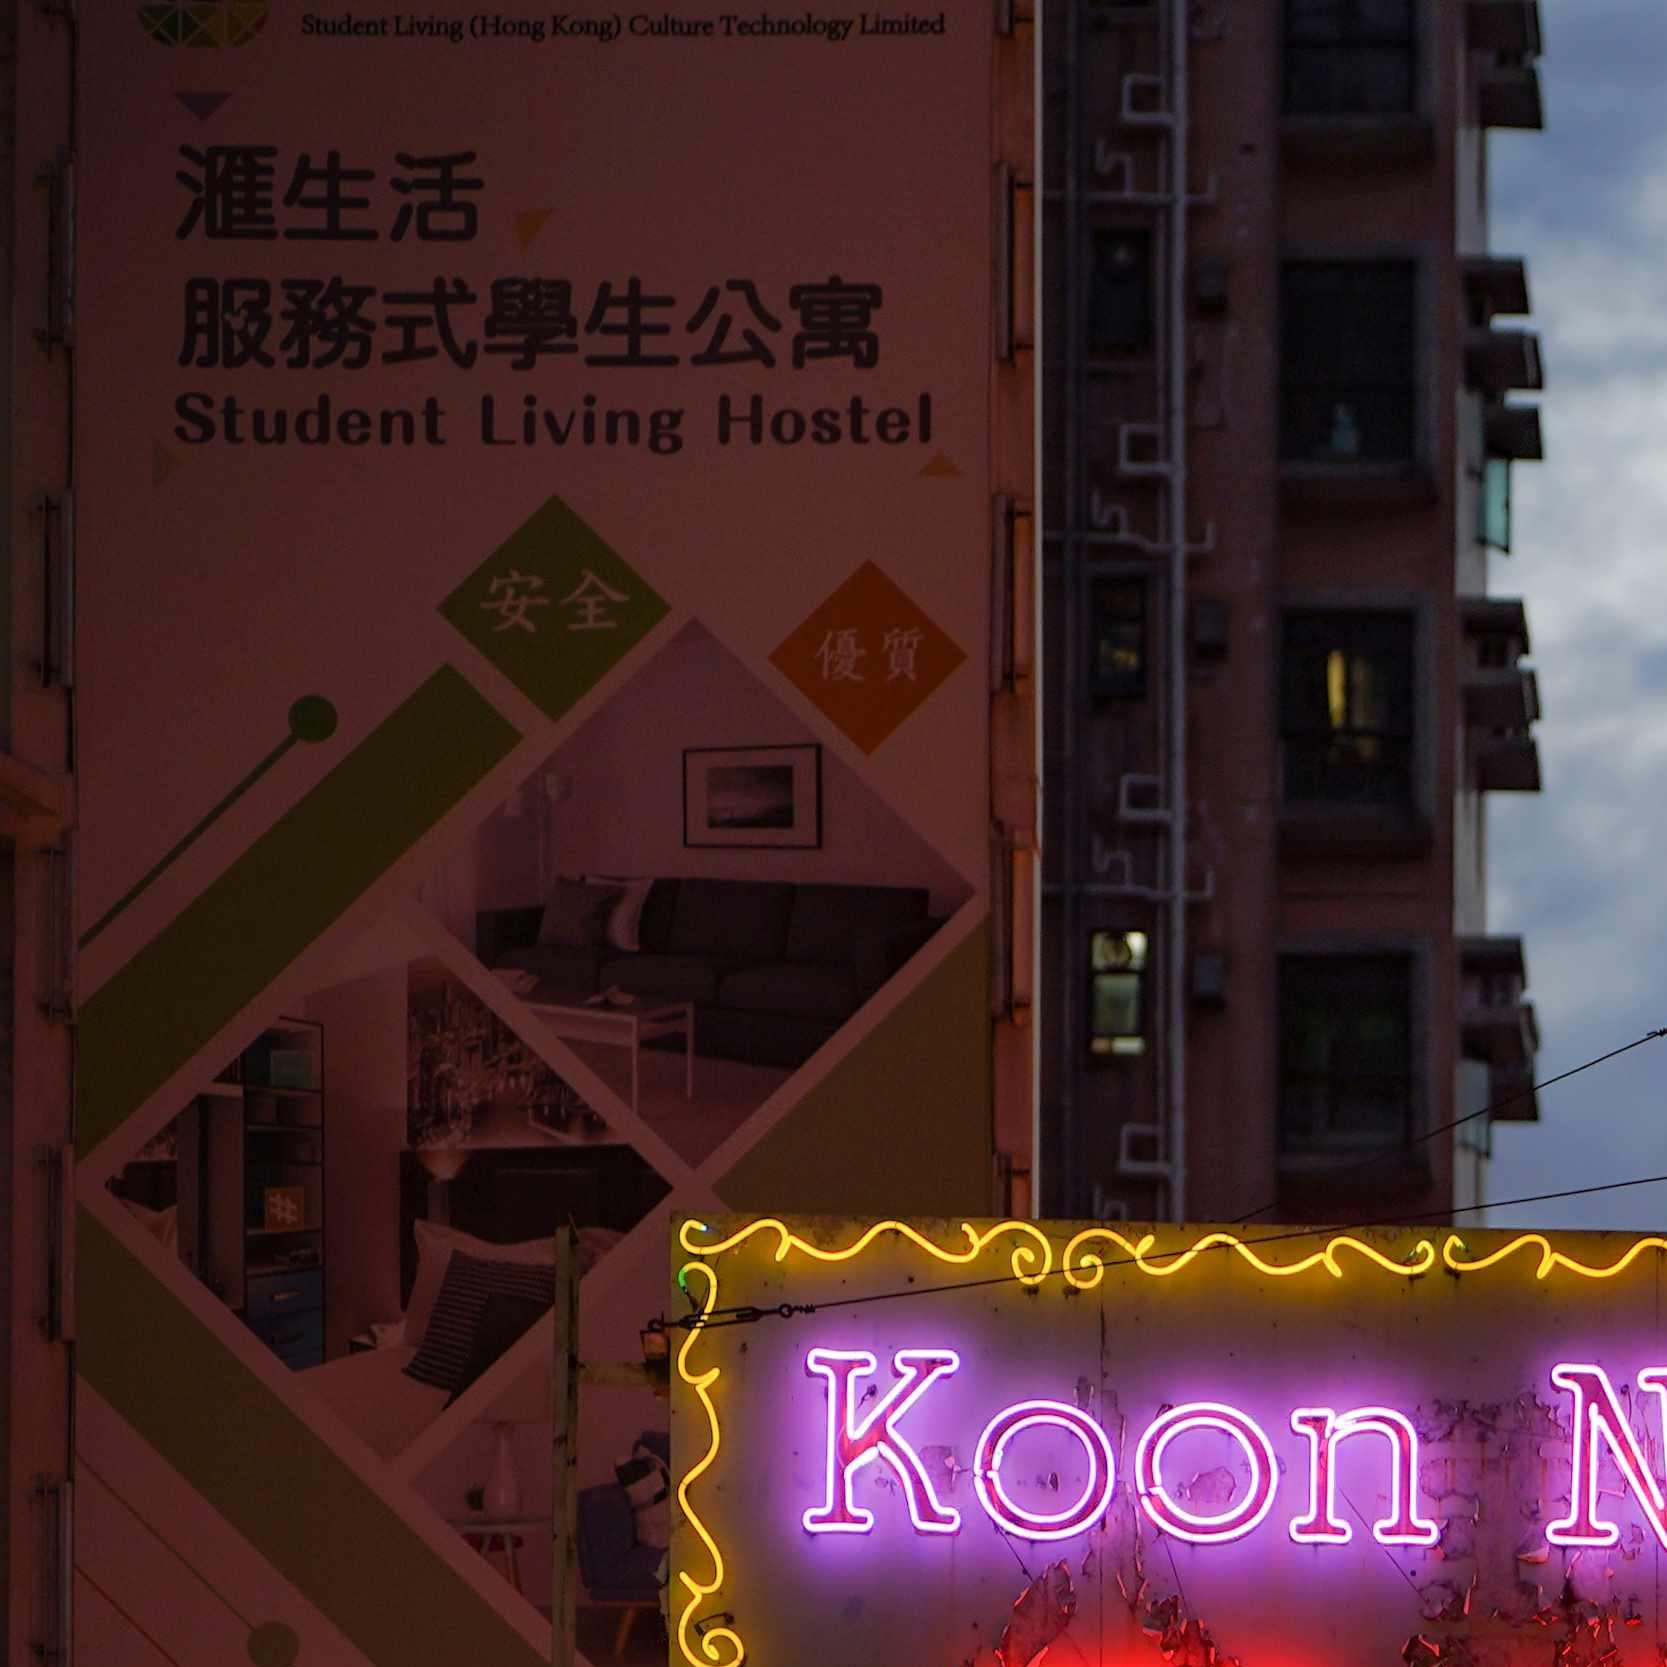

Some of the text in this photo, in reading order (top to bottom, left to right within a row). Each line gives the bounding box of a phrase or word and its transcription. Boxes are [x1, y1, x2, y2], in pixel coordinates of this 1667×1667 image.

[302, 12, 946, 41] Student Living (Hong Kong) Culture Technology Limited
[178, 275, 882, 370] 服務式學生公寓
[173, 391, 932, 455] Student Living Hostel
[479, 568, 631, 633] 安全
[813, 624, 927, 682] 優質
[801, 1346, 1442, 1545] Koon
